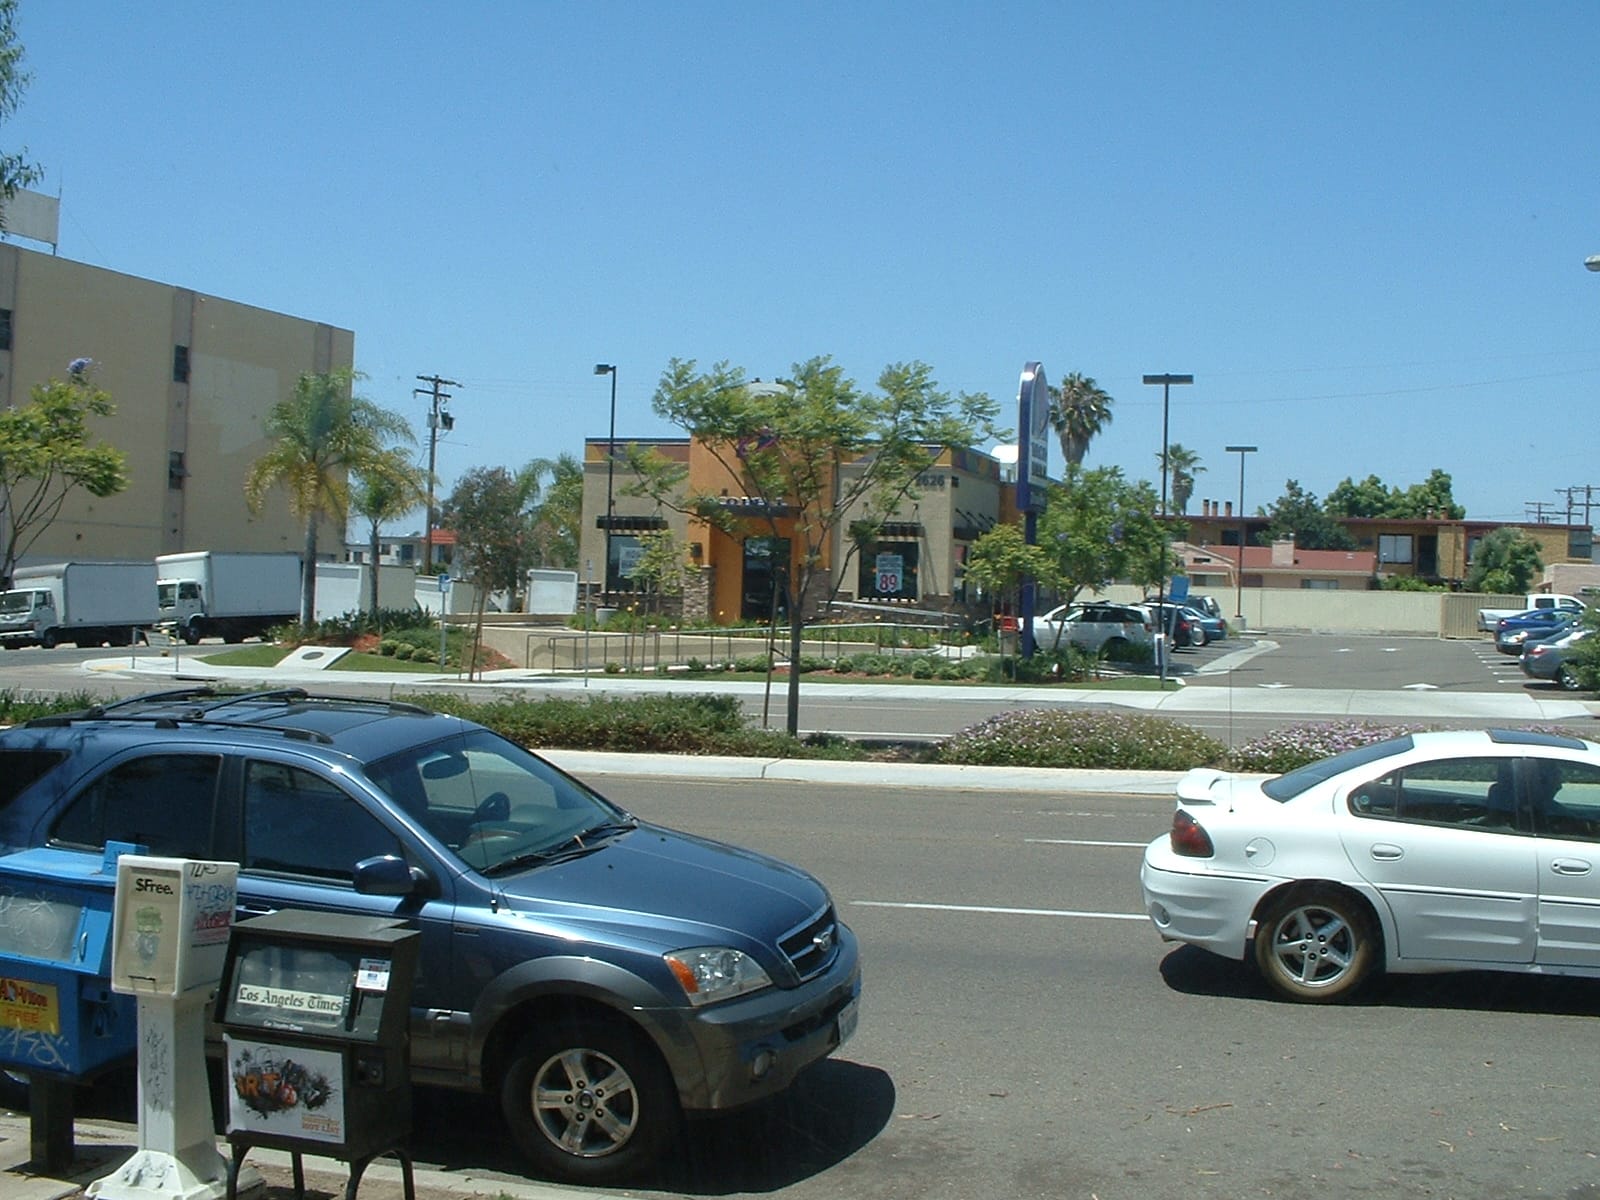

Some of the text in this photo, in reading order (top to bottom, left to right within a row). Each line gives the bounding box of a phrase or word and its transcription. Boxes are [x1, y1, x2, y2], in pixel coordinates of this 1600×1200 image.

[239, 986, 342, 1012] Los Angeles Times
